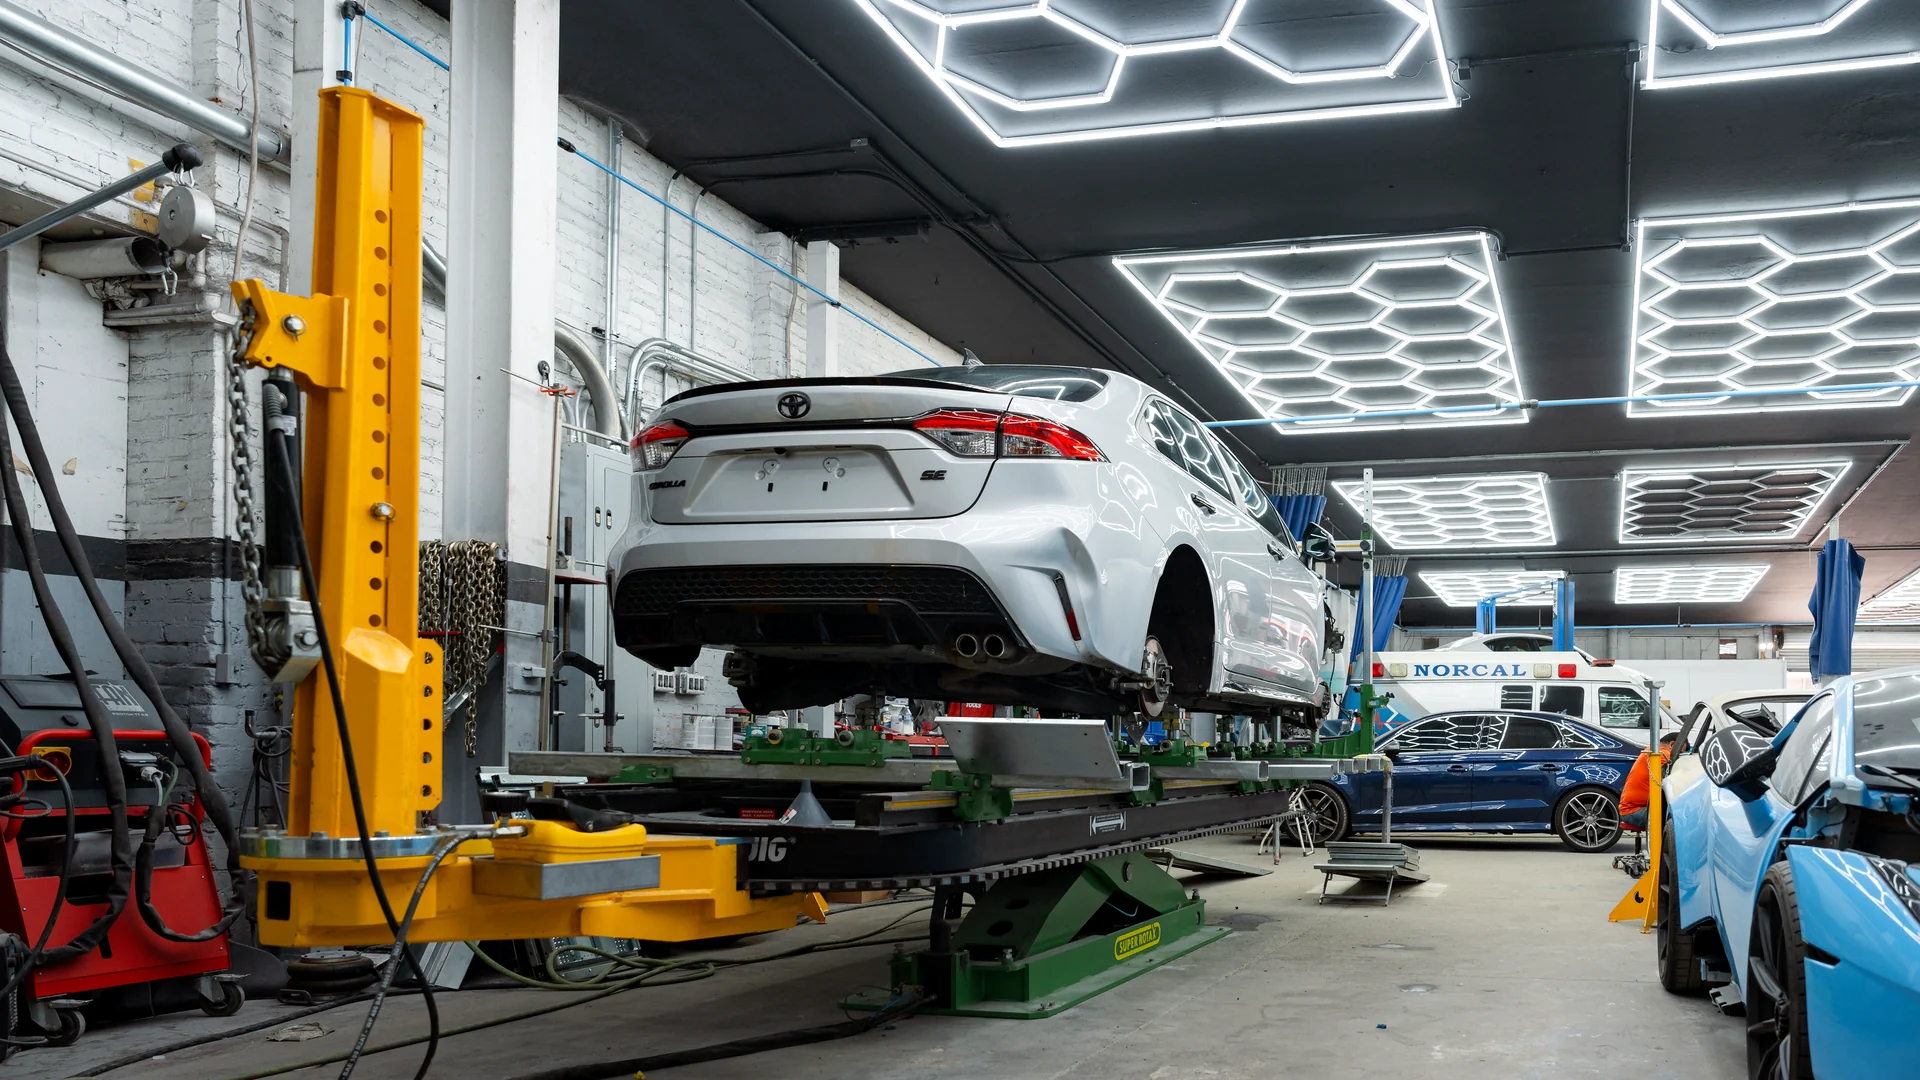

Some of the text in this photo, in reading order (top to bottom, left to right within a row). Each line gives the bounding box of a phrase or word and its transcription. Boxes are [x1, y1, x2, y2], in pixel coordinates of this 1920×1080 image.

[920, 470, 947, 480] SE
[1414, 664, 1527, 676] NORCAL
[1120, 924, 1156, 953] SUPER ROTAX
